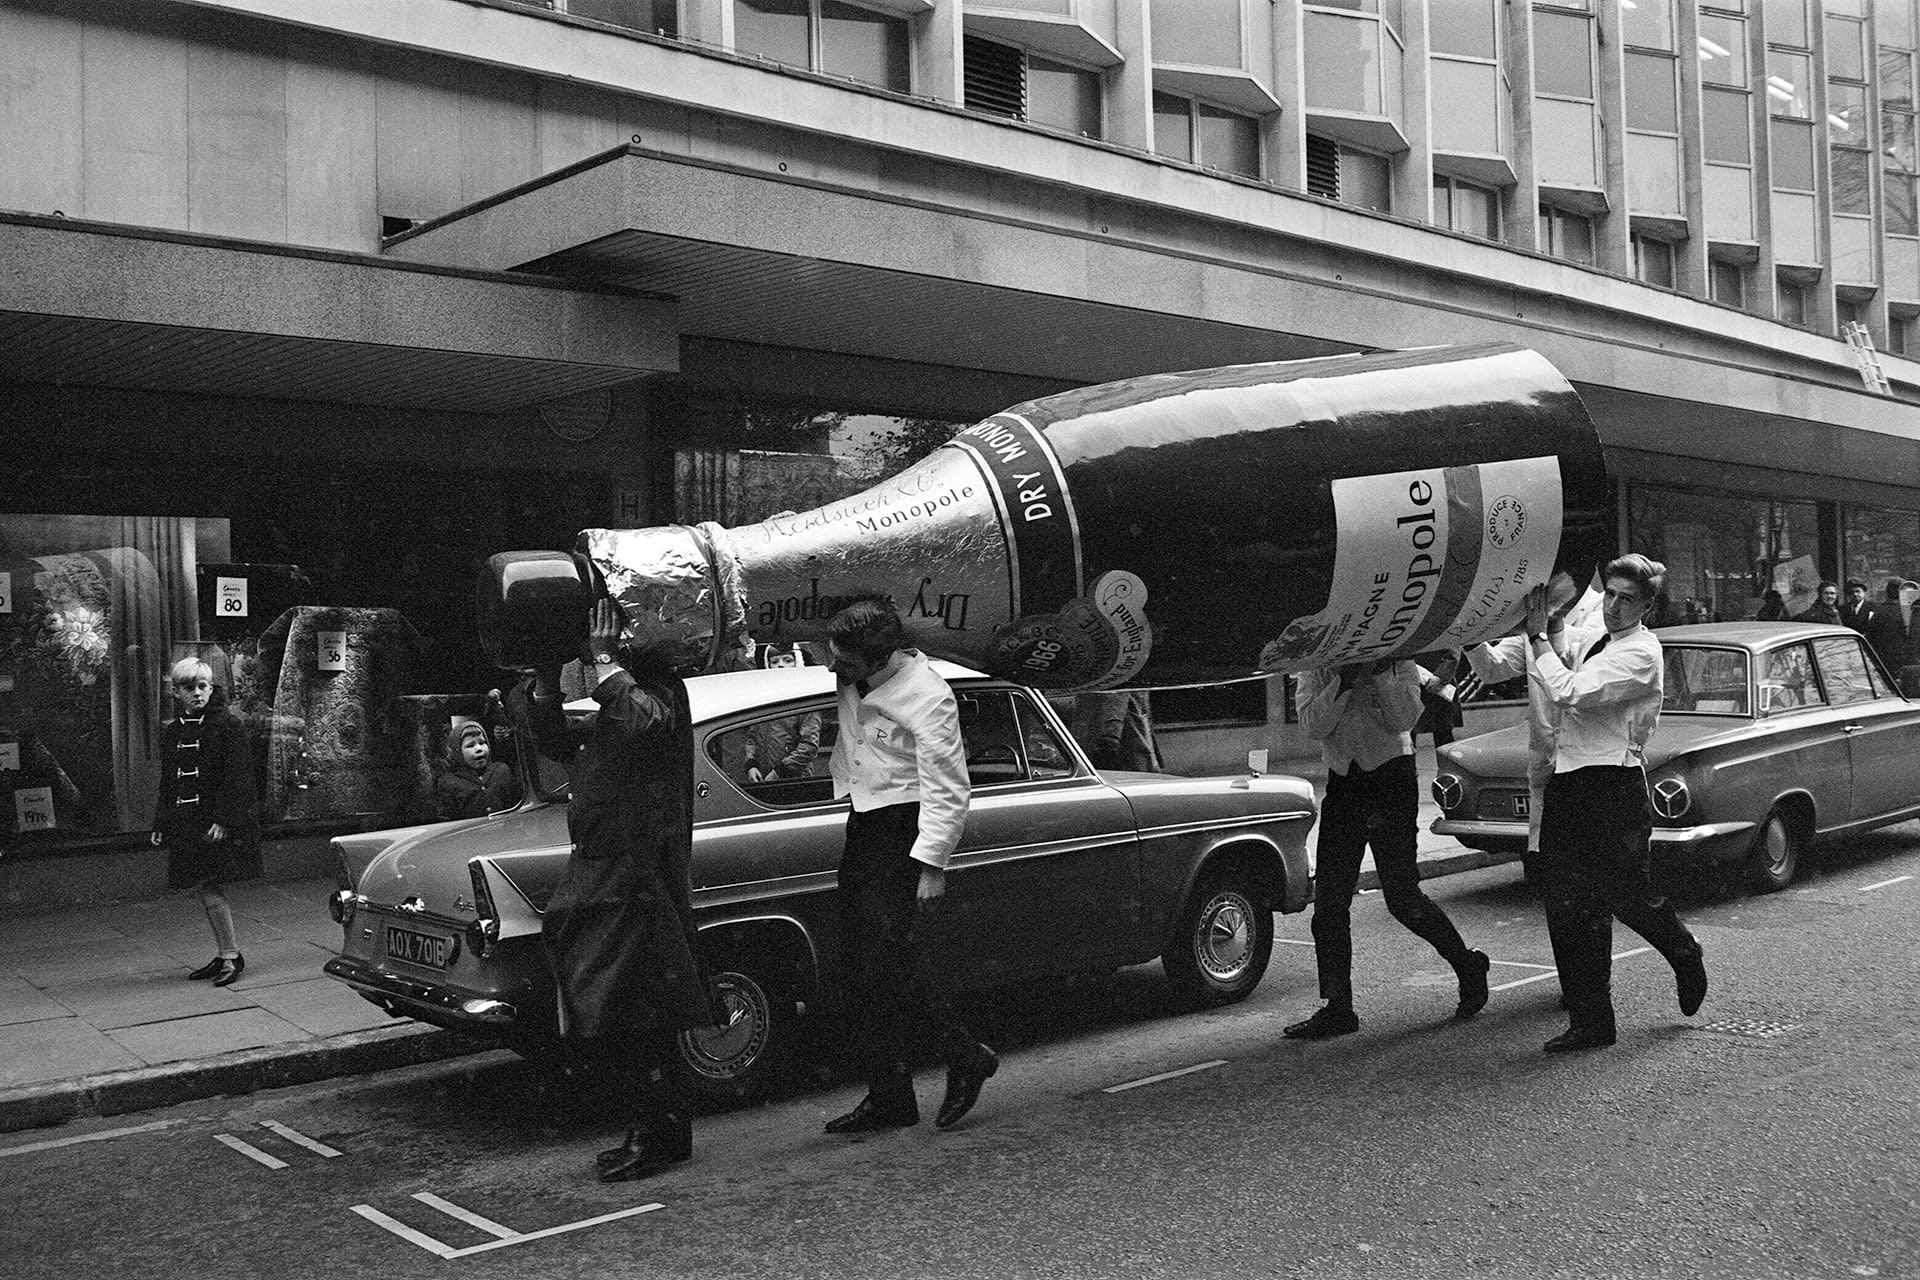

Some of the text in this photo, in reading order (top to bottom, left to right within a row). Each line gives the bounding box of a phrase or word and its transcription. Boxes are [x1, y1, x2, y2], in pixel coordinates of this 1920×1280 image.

[855, 485, 975, 535] Monopole
[1012, 471, 1053, 522] DRY
[1489, 500, 1508, 546] PRODUCE
[1510, 501, 1525, 541] FRANCE
[1512, 558, 1530, 586] 1785
[224, 598, 242, 612] 80
[758, 577, 971, 634] Dry opole
[1110, 603, 1145, 671] for England
[328, 650, 341, 663] 56
[1022, 640, 1062, 672] 1966
[1514, 796, 1530, 814] H
[389, 929, 413, 960] AOX
